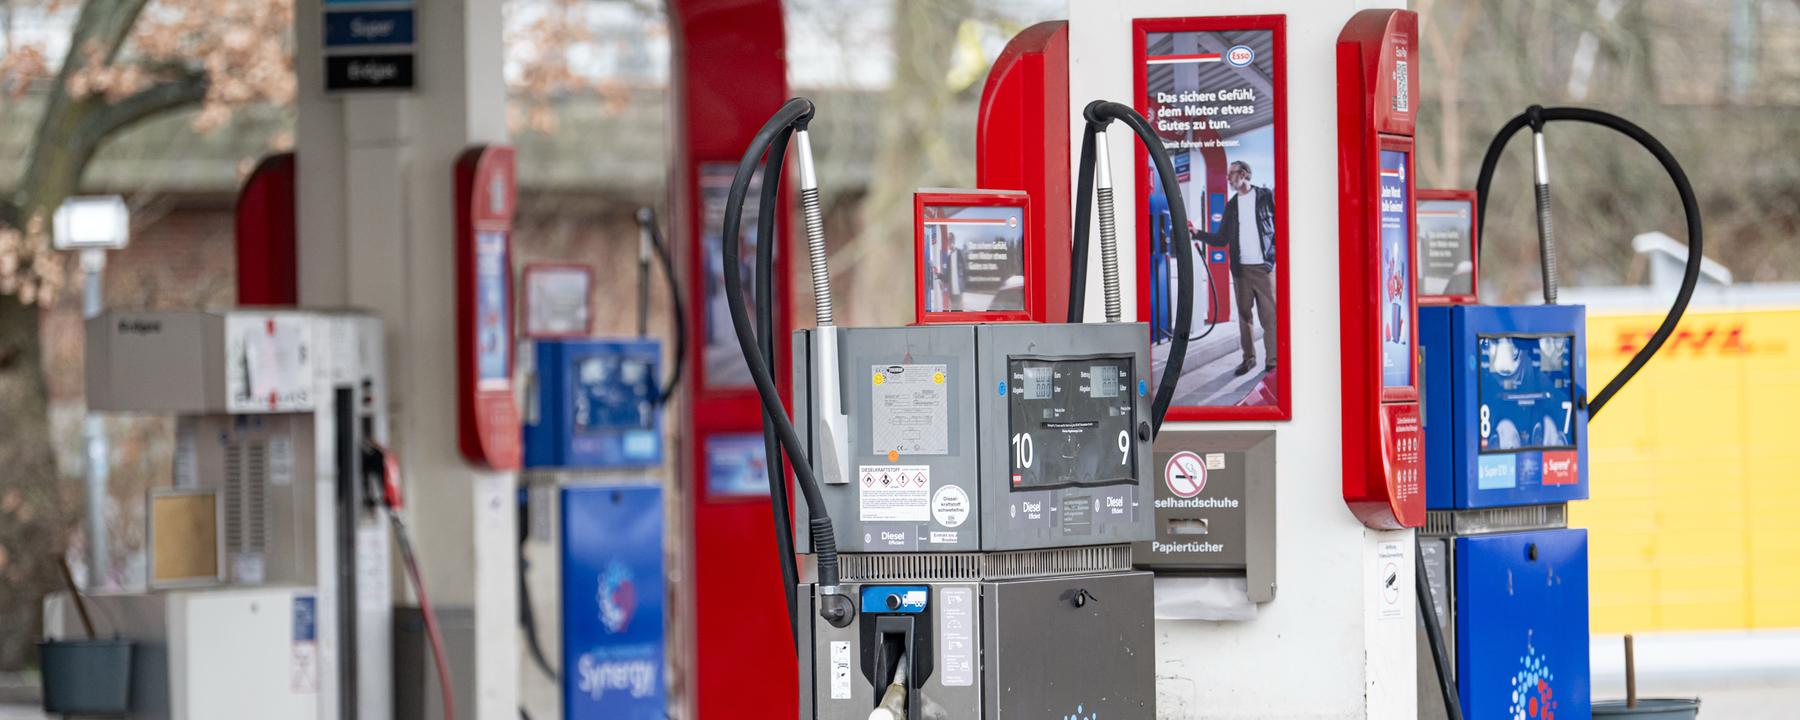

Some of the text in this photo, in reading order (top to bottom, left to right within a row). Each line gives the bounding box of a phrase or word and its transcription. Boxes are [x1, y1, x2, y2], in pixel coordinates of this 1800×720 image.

[349, 18, 395, 39] Super
[1232, 52, 1250, 60] Esso
[1157, 89, 1256, 103] Das sichere Gefühl,
[1158, 105, 1254, 117] dem Motor etwas
[1158, 120, 1231, 131] Gutes zu tun.
[1181, 140, 1202, 148] fahren
[1216, 139, 1240, 147] besser.
[1480, 404, 1491, 438] 8
[1561, 401, 1572, 434] 7
[1012, 432, 1033, 469] 10
[1118, 430, 1130, 465] 9
[1023, 501, 1040, 513] Diesel
[1107, 496, 1123, 508] Diesel
[1154, 497, 1239, 508] selhandschuhe
[881, 532, 905, 540] Diesel
[1152, 542, 1224, 554] Papiertücher
[578, 654, 655, 700] Synergy
